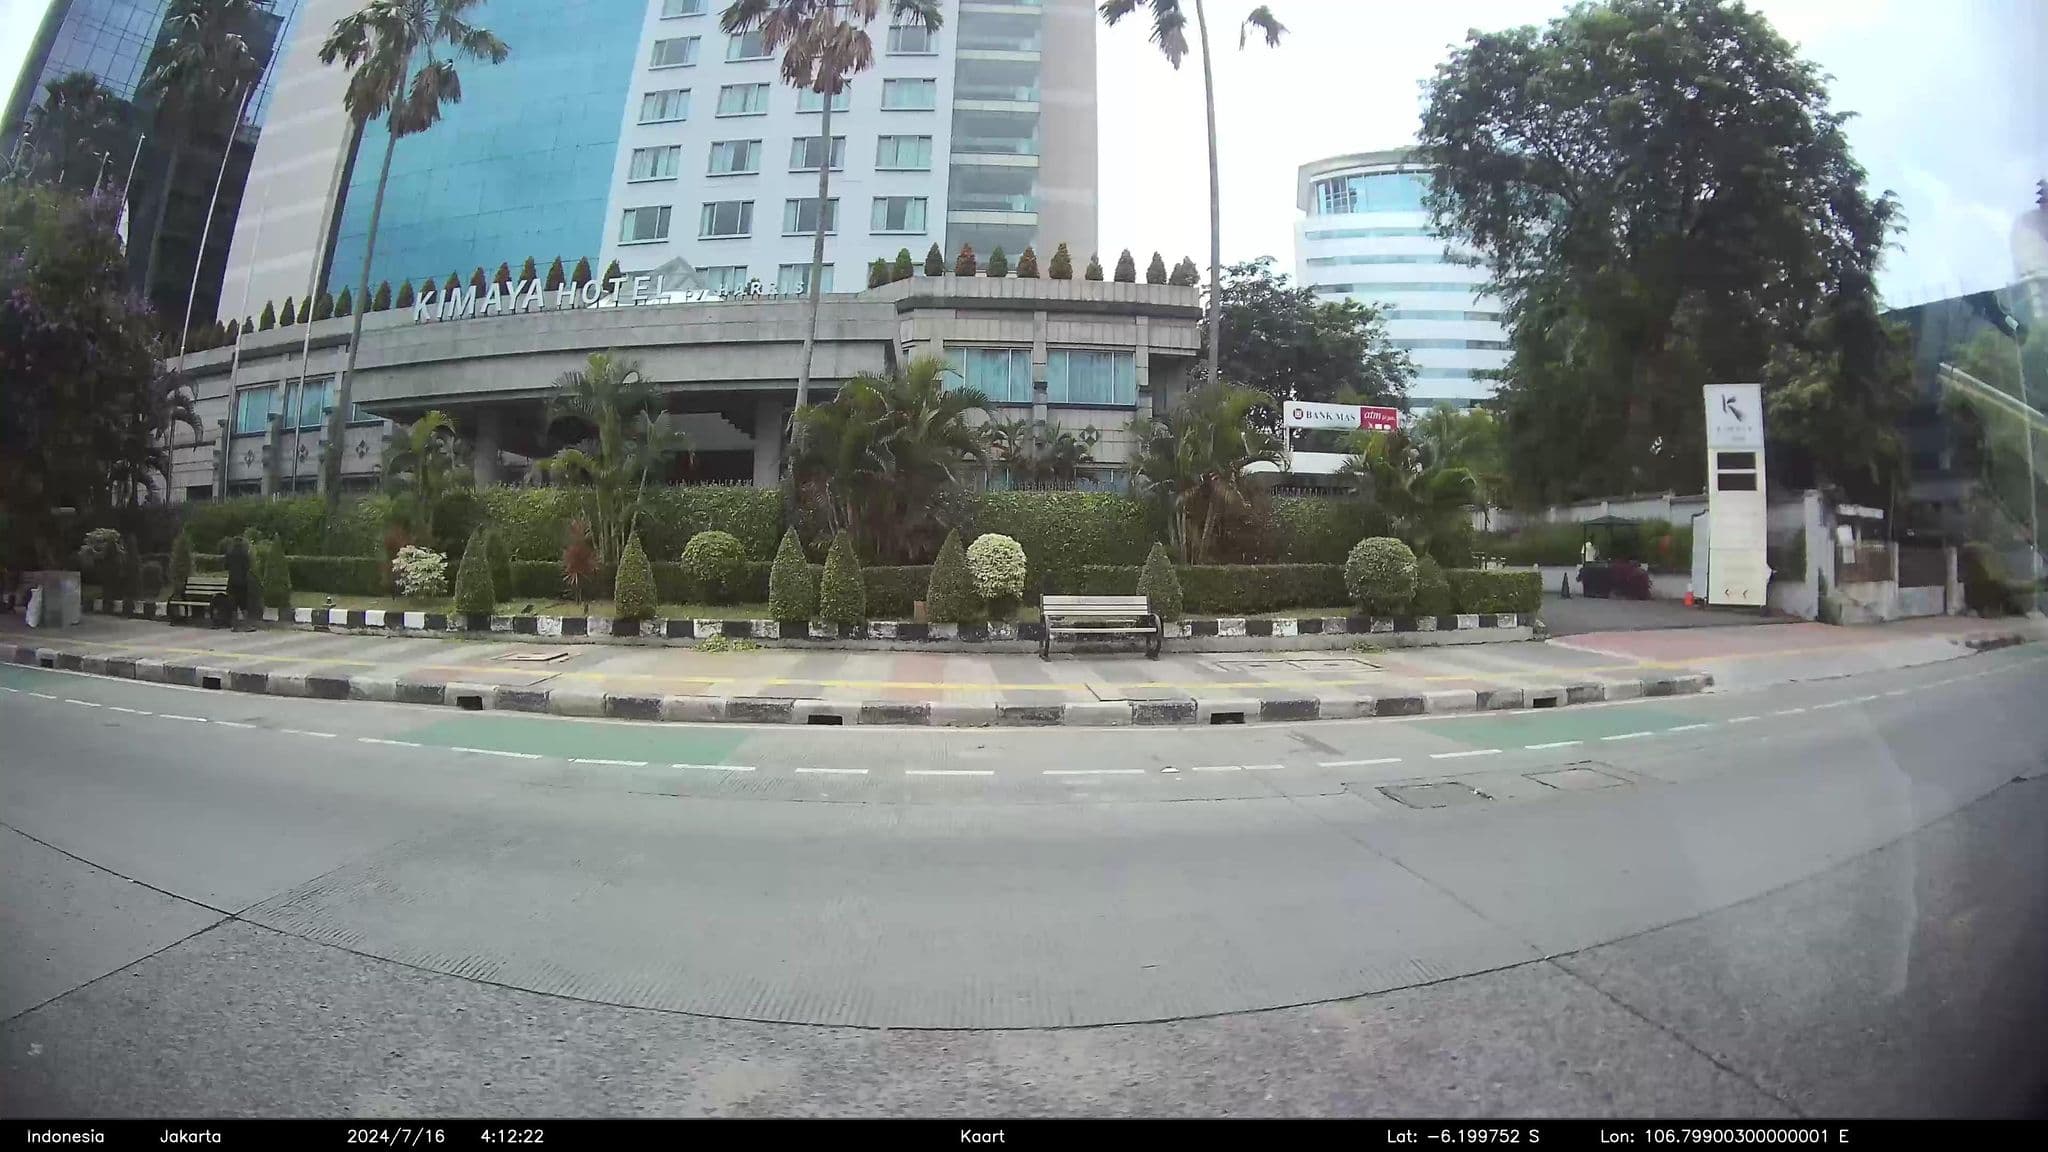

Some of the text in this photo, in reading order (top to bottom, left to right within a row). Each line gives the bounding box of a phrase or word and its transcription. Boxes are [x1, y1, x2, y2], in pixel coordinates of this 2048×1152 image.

[414, 277, 545, 322] KIMAYA
[557, 275, 672, 310] HOTEL
[1306, 410, 1356, 422] BANK MAS
[1364, 410, 1382, 420] atm
